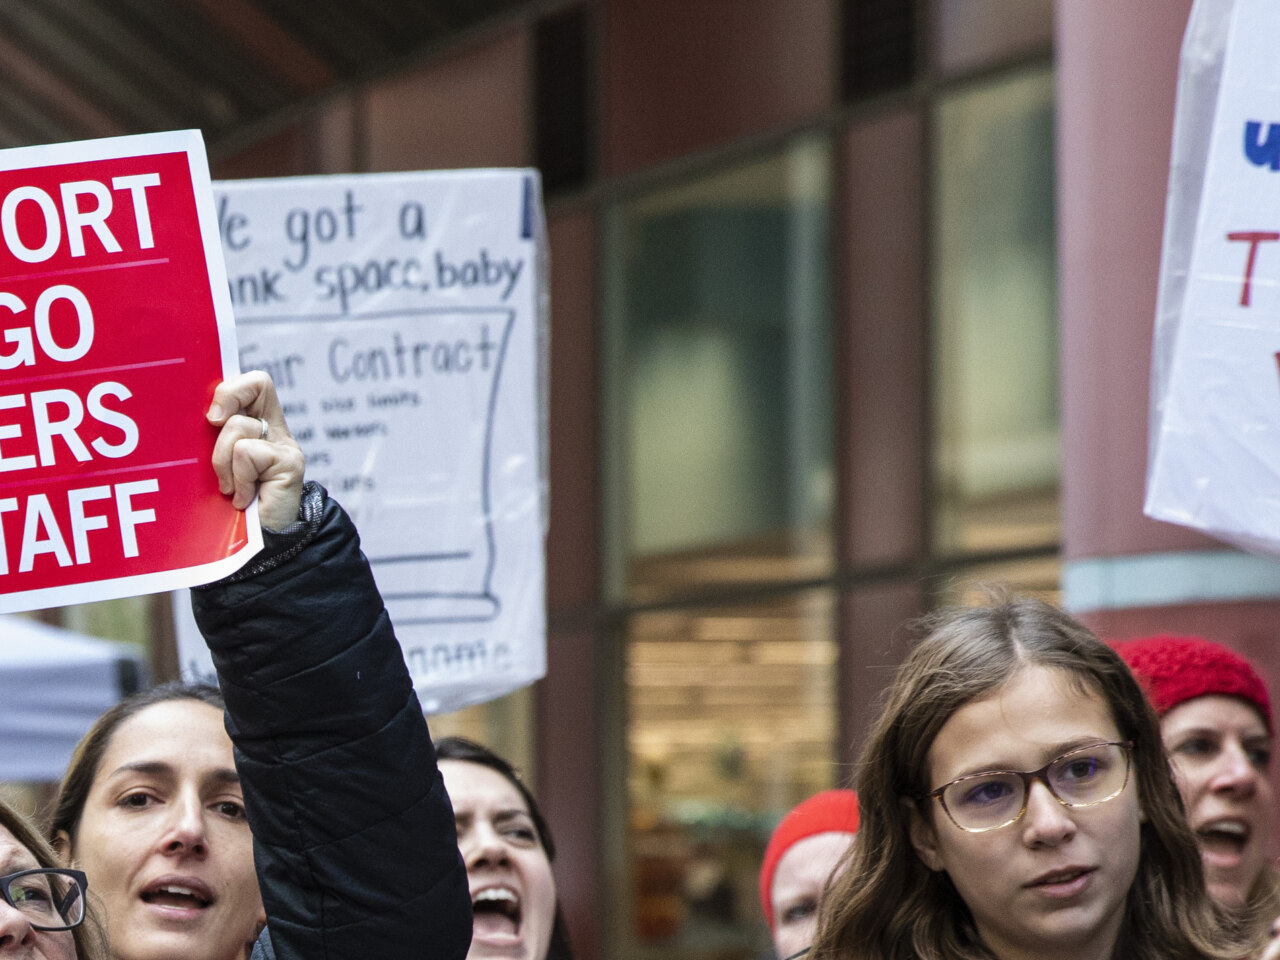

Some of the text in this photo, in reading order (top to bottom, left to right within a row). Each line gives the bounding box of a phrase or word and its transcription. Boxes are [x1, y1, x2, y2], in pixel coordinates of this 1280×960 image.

[283, 189, 365, 272] got
[398, 200, 426, 242] a
[327, 324, 496, 384] Contract
